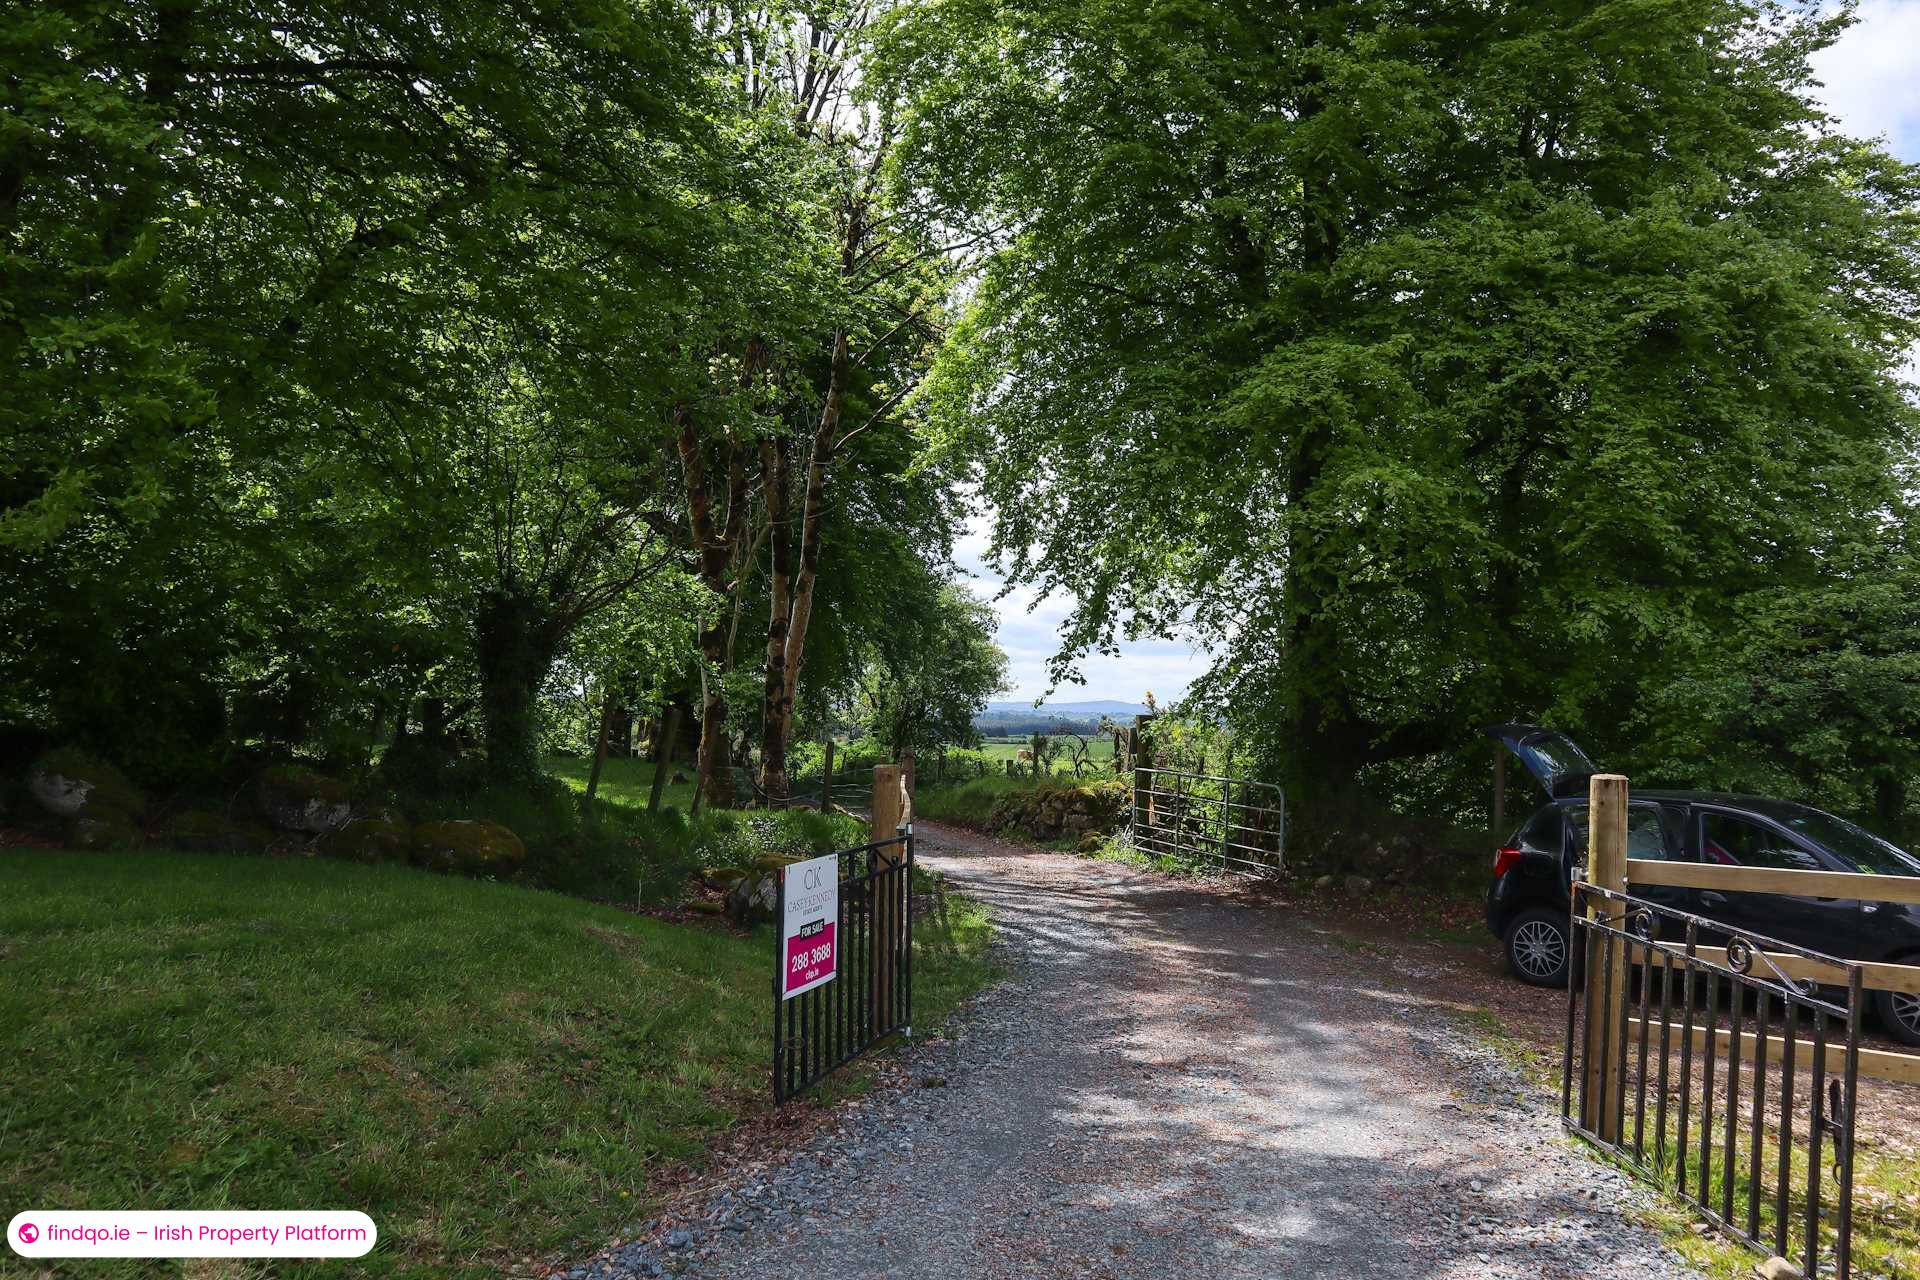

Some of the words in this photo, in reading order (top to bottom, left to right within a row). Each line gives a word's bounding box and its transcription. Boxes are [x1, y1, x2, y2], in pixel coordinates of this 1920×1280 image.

[801, 926, 811, 938] FOR
[812, 921, 823, 934] SALE
[792, 951, 808, 973] 288
[811, 941, 831, 965] 3688
